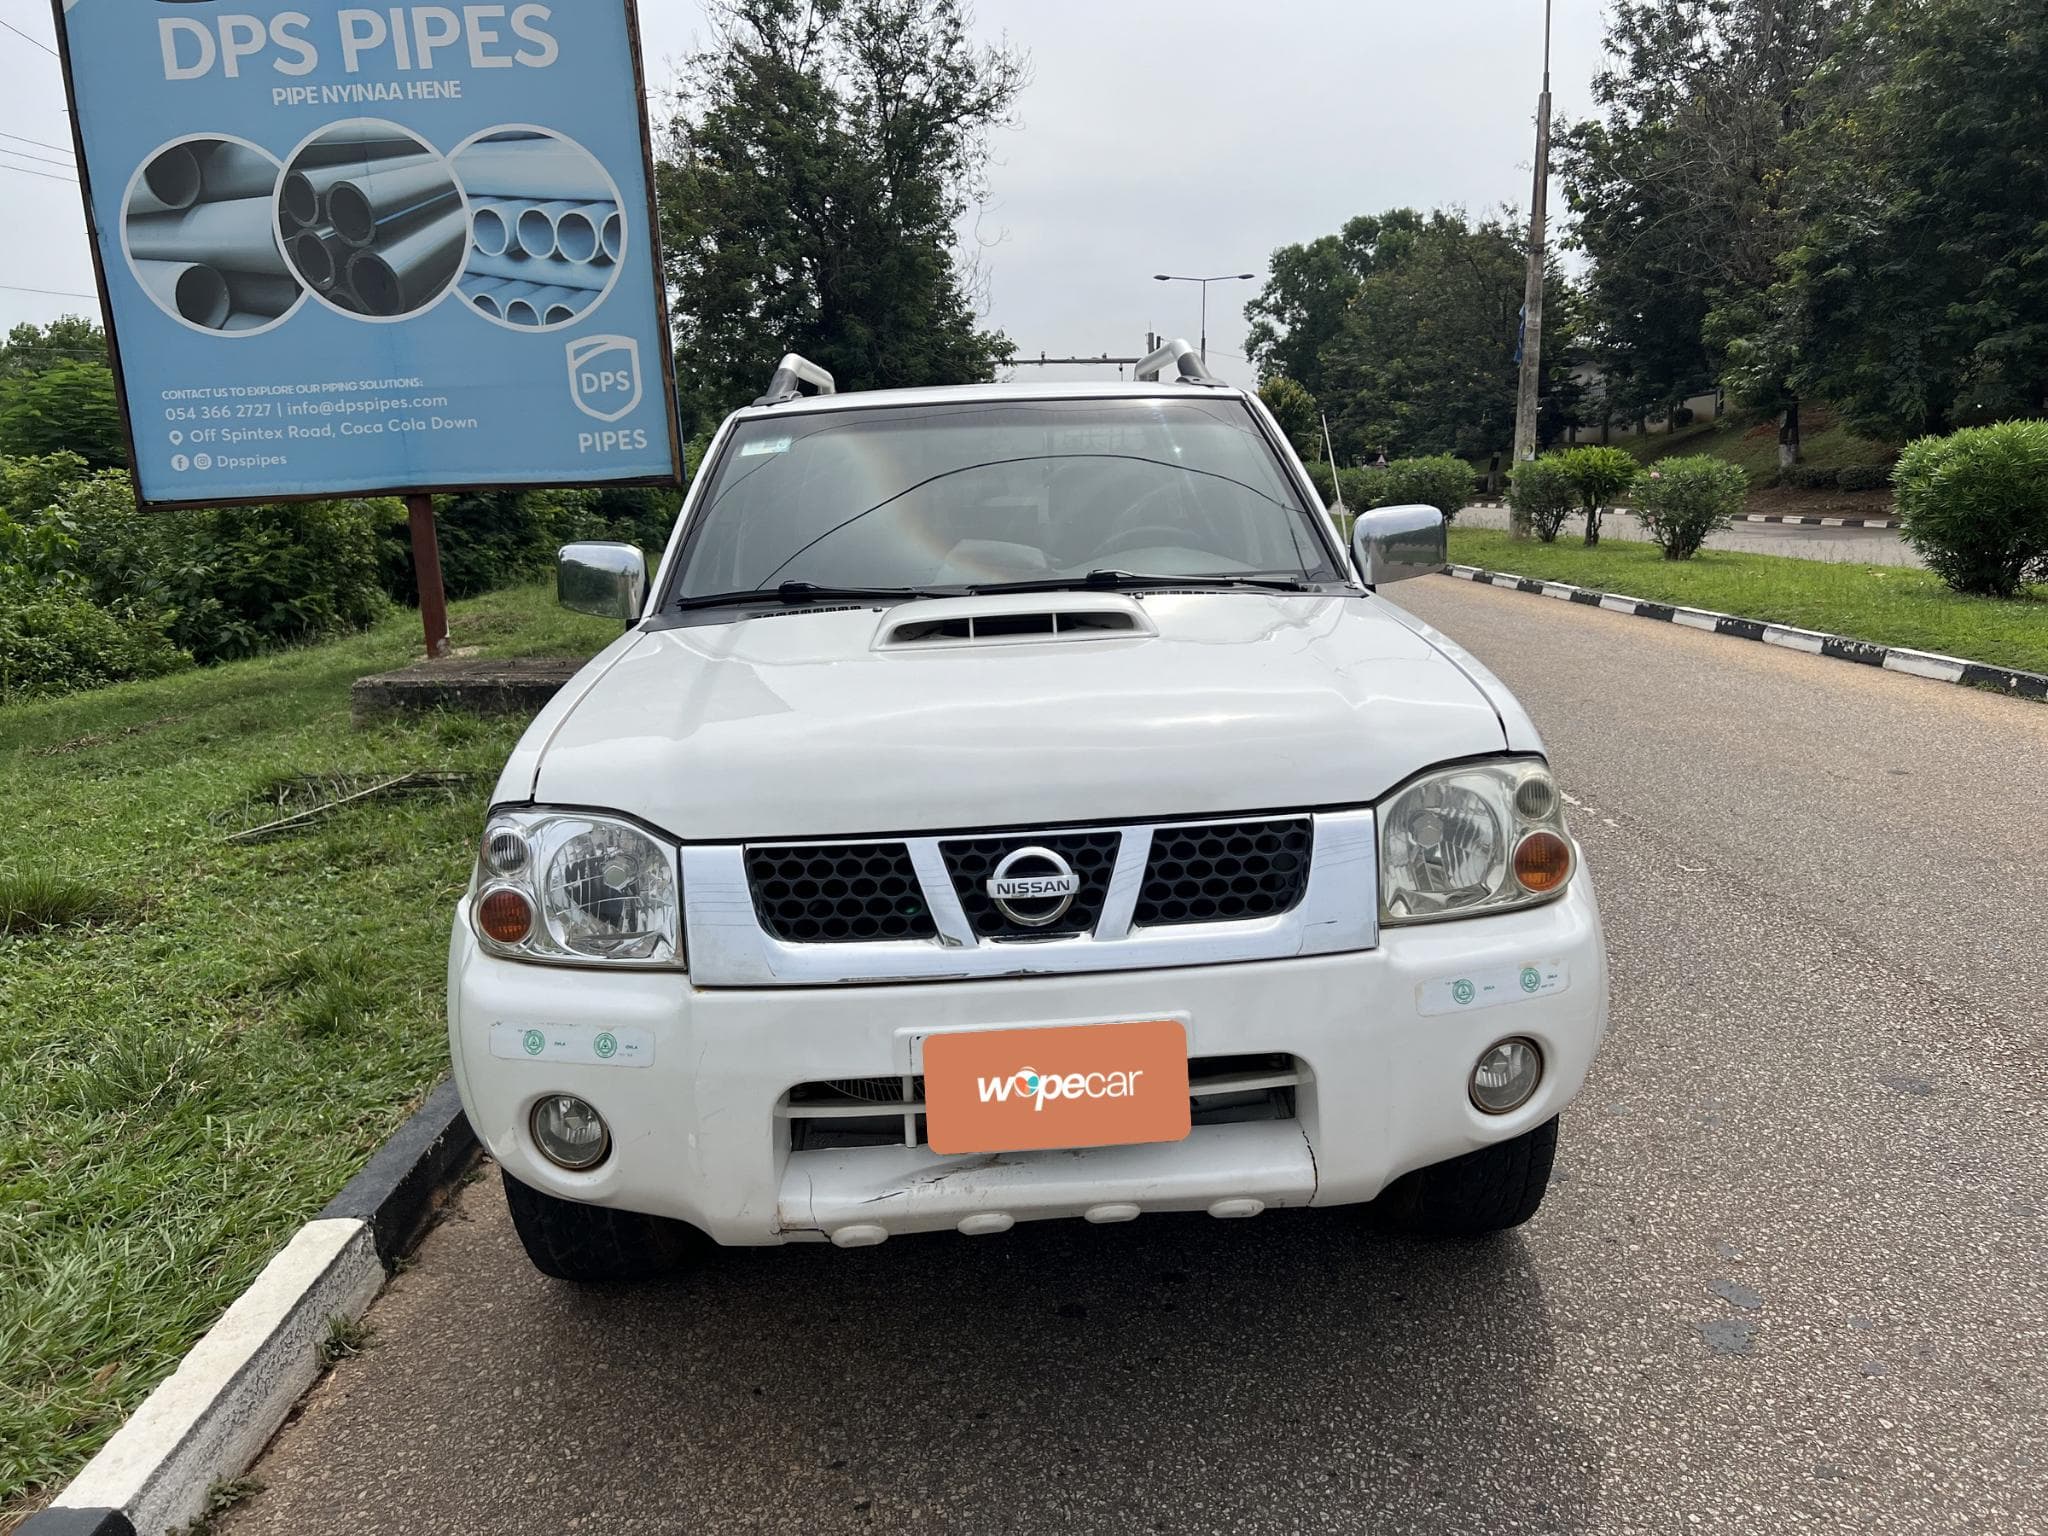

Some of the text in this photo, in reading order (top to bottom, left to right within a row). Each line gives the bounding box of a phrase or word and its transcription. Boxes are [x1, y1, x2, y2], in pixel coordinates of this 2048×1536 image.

[158, 3, 559, 80] DPS PIPES
[272, 80, 462, 106] PIPE NYINAA HENE
[161, 377, 424, 400] CONTACT US TO EXPLORE OUR PIPING SOLUTIONS:
[581, 370, 630, 394] DPS
[165, 407, 196, 421] 054
[201, 405, 231, 419] 366
[236, 403, 271, 418] 2727
[287, 396, 448, 416] info@dpspipes.com
[190, 416, 478, 444] Off Spintex Road, Coca Cola Down
[578, 428, 648, 454] PIPES
[217, 453, 288, 470] Dpspipes
[997, 880, 1070, 894] NISSAN
